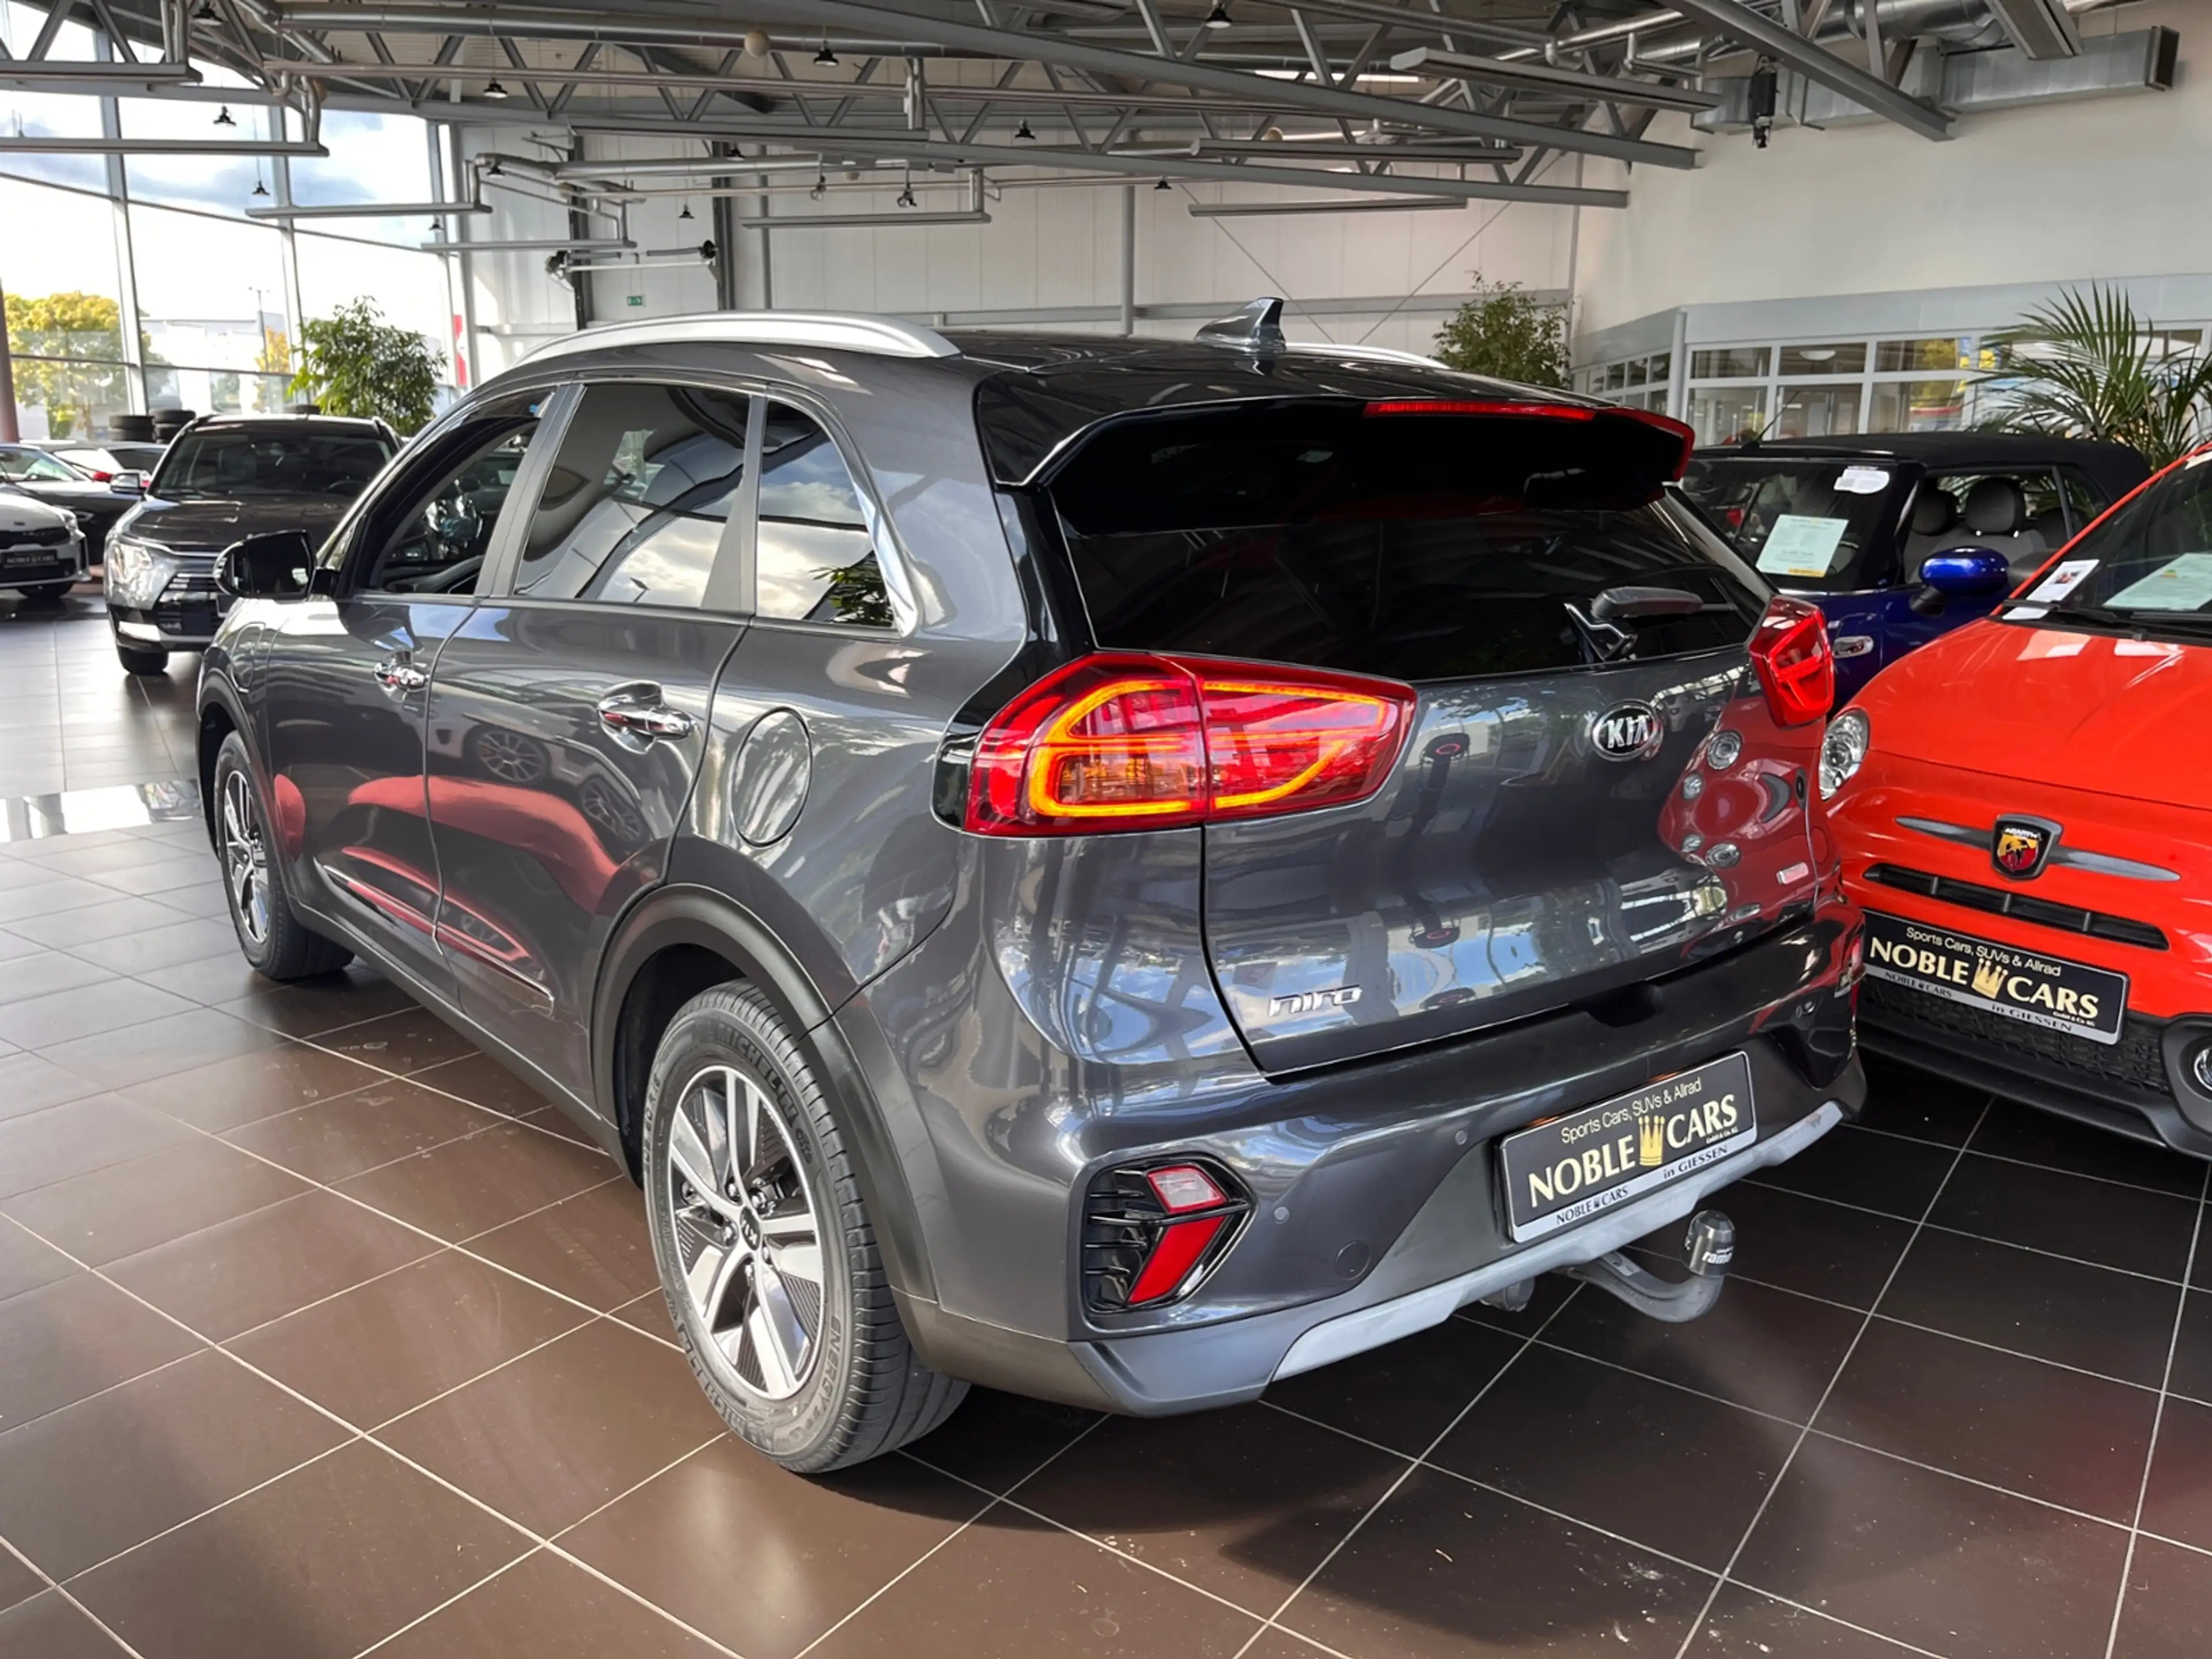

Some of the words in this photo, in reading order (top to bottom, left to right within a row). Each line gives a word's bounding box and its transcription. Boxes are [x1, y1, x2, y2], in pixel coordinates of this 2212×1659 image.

[1607, 715, 1649, 749] KIA
[1869, 937, 1970, 986] NOBLE
[2007, 976, 2100, 1020] CARS
[1906, 926, 1942, 946] Sports
[1944, 937, 1974, 956] Cars,
[1976, 945, 2010, 964] SUVs
[2012, 955, 2022, 967] &
[2024, 958, 2061, 977] Allrad
[1926, 984, 1952, 998] CARS
[1991, 1003, 2005, 1015] in
[2009, 1009, 2073, 1032] GIESSEN
[1560, 1118, 1601, 1144] Sports
[1602, 1108, 1633, 1128] Cars,
[1632, 1094, 1662, 1116] SUVs
[1662, 1089, 1672, 1104] &
[1674, 1077, 1702, 1101] Allrad
[1528, 1134, 1636, 1209] NOBLE
[1666, 1094, 1737, 1149] CARS
[1556, 1201, 1592, 1225] NOBLE
[1601, 1185, 1629, 1208] CARS
[1663, 1169, 1676, 1179] in
[1677, 1145, 1728, 1173] GIESSEN
